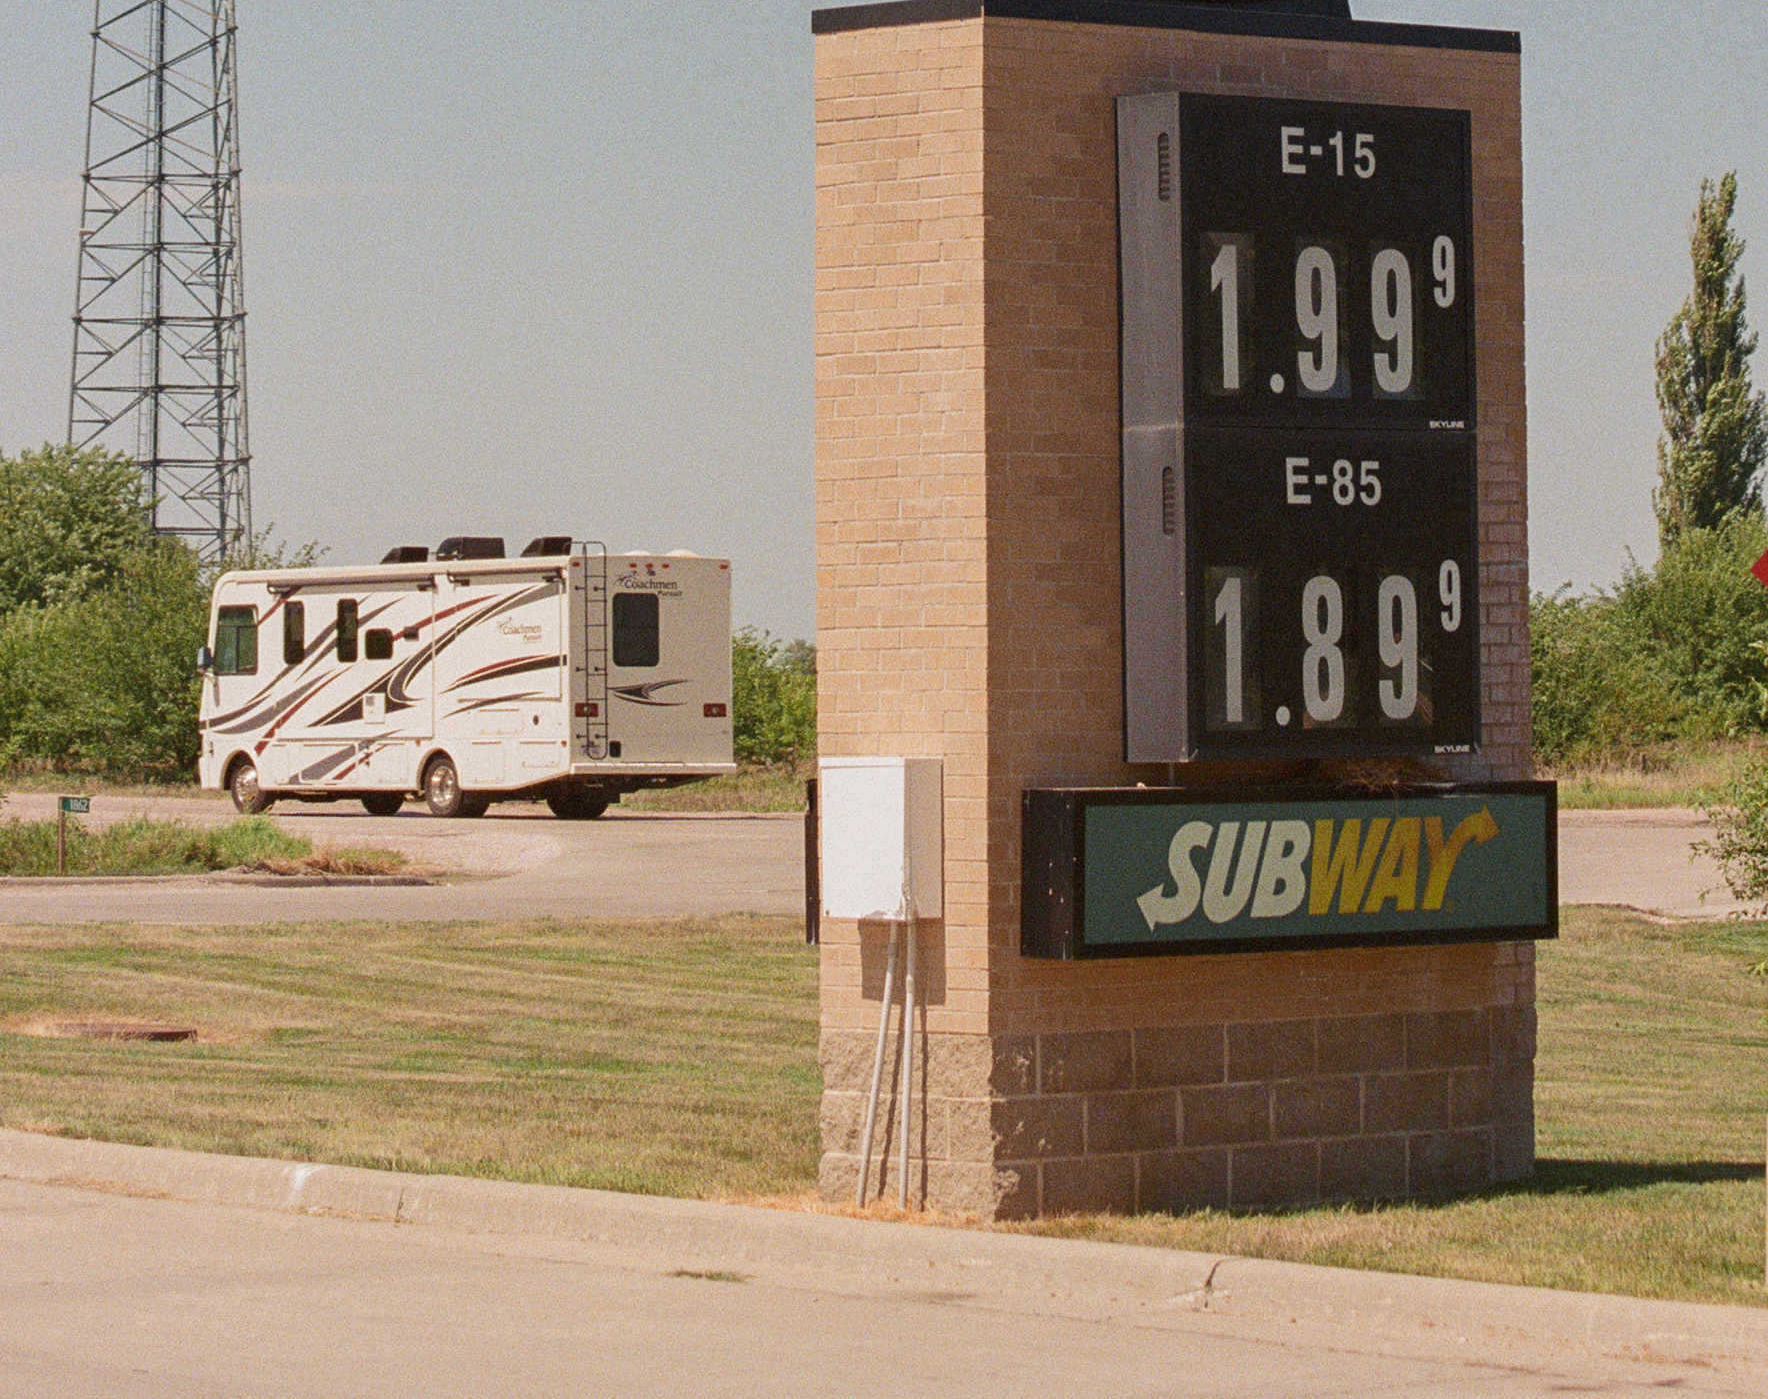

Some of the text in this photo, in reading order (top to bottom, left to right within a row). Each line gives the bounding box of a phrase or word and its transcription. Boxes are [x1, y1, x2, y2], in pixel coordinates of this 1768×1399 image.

[1280, 126, 1377, 179] E-15
[1429, 420, 1465, 429] SKYLINE
[1285, 457, 1383, 506] E-85
[624, 578, 678, 590] Coachmen
[1136, 804, 1499, 932] SUBWAY
